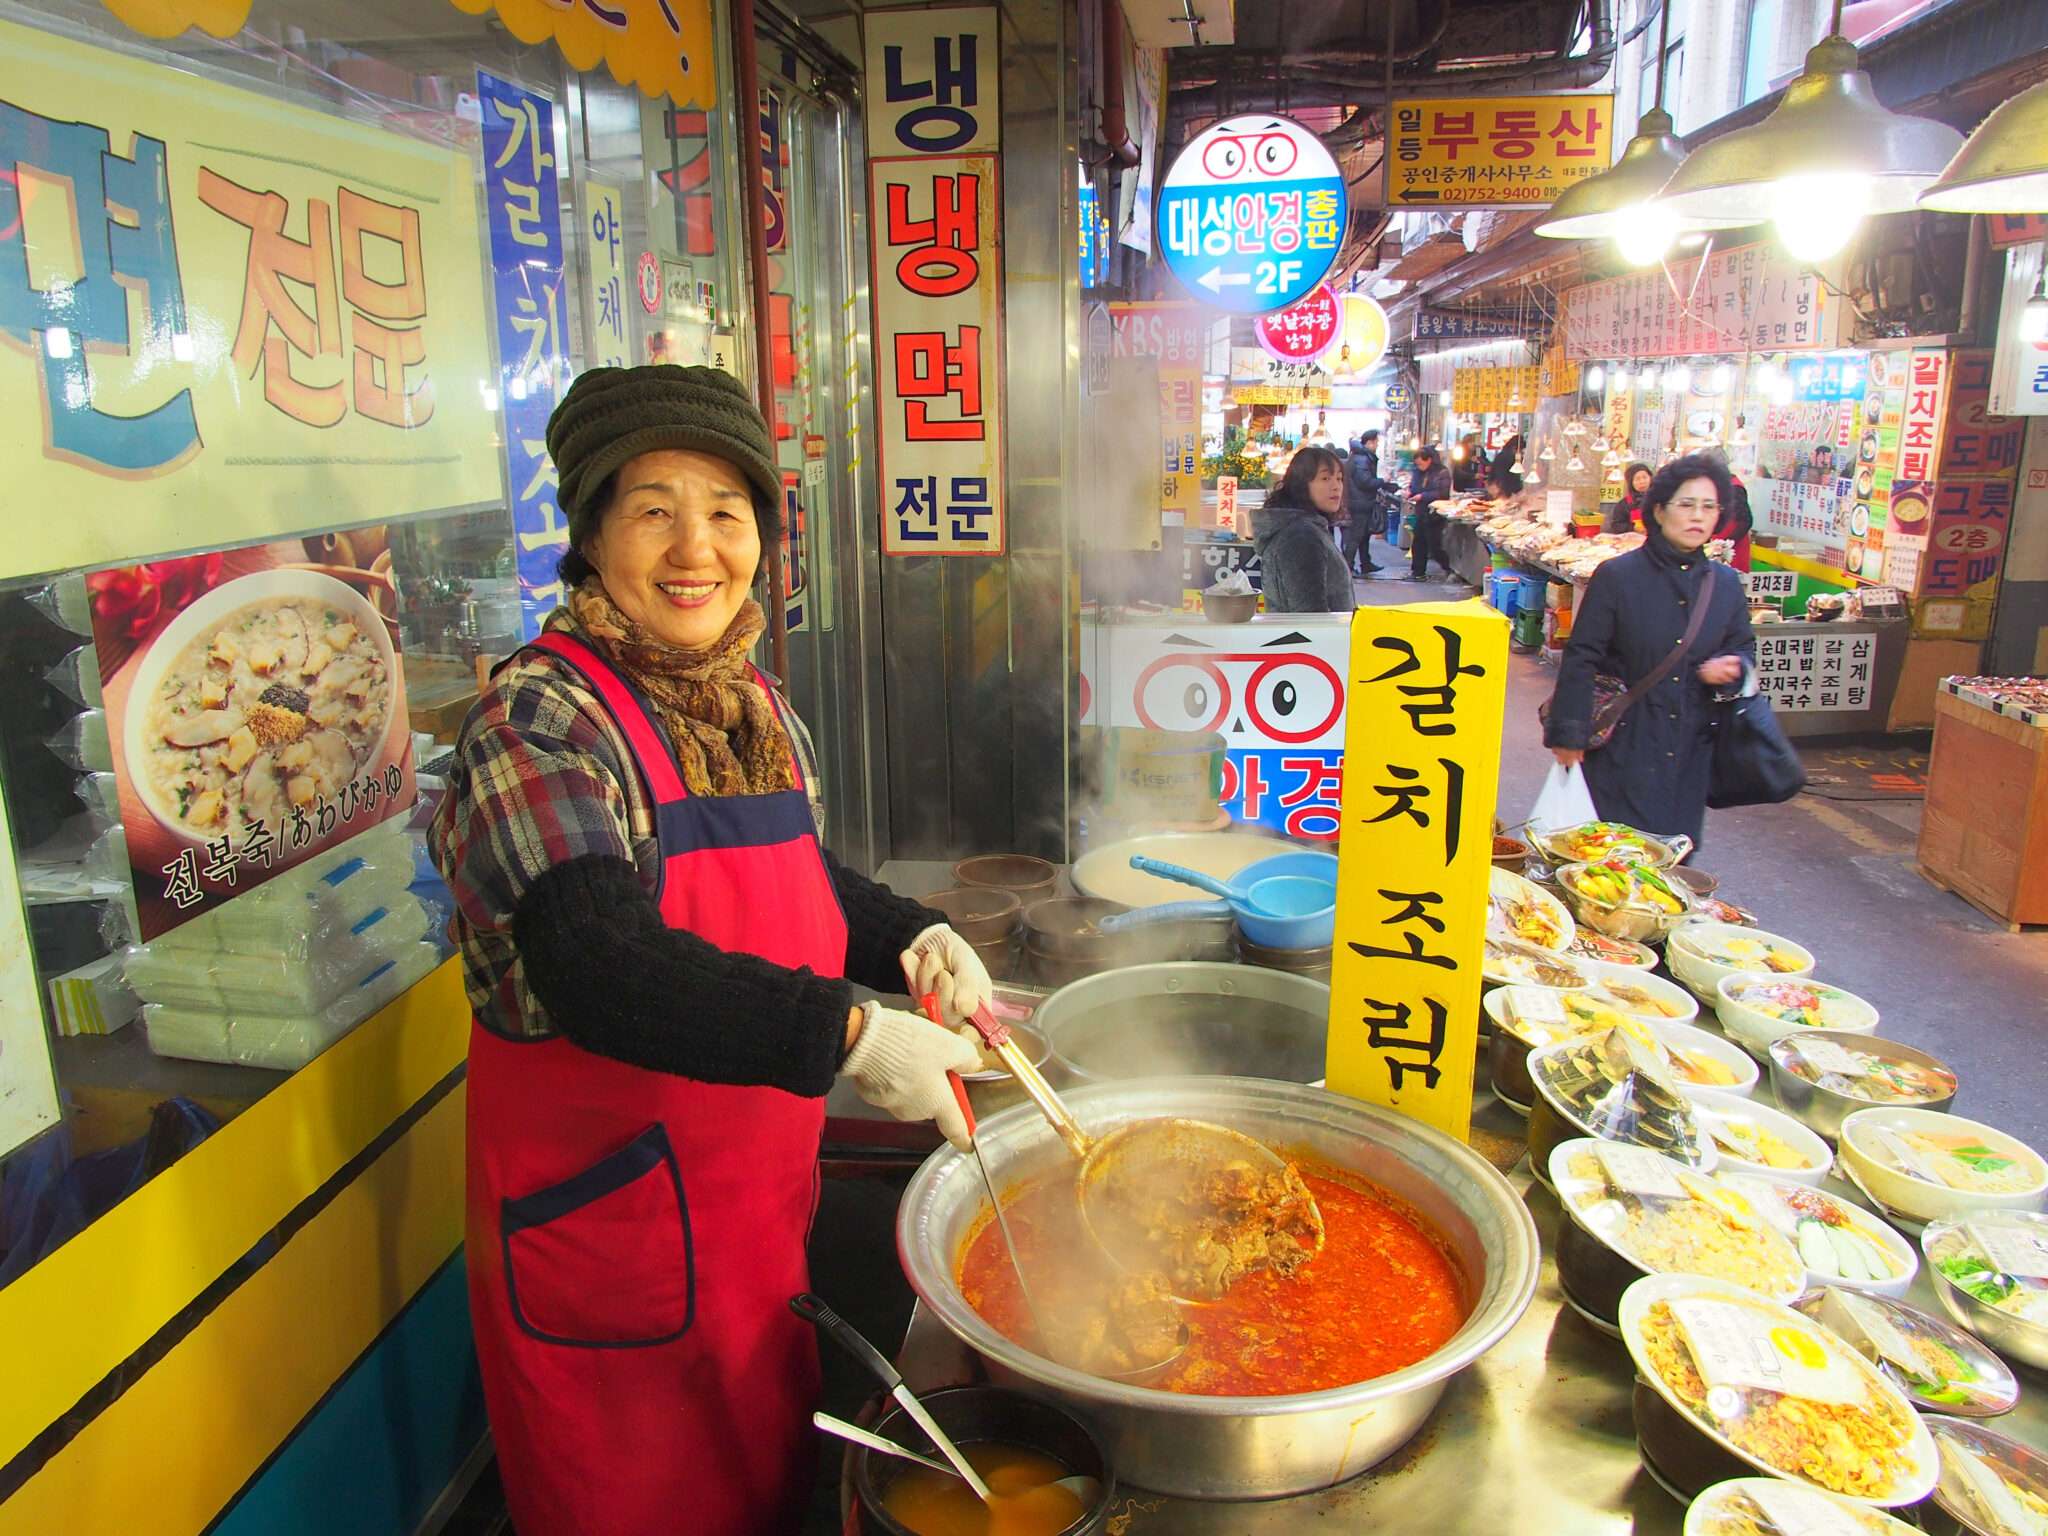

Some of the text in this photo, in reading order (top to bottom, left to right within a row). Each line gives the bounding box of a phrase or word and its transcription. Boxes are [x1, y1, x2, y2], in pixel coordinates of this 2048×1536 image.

[884, 33, 979, 153] 냉
[1397, 107, 1603, 162] 일등 부동산
[1402, 164, 1553, 185] 공인중개사사무소
[1443, 187, 1541, 201] 02)752-9400
[1167, 190, 1303, 256] 대성안경
[1305, 189, 1340, 250] 총판
[198, 164, 435, 429] 전문
[593, 196, 627, 368] 야채
[1255, 259, 1304, 295] 2F
[886, 172, 986, 443] 냉면
[1113, 315, 1164, 360] KBS
[494, 96, 572, 636] 갈치조
[1902, 356, 1943, 481] 갈치조림
[1946, 431, 2018, 469] 도매
[893, 474, 994, 542] 전문
[1937, 484, 2010, 520] 그릇
[1947, 528, 1989, 549] 2층
[1751, 575, 1793, 592] 갈치조림
[1760, 657, 1813, 672] 보리 밥
[1761, 638, 1815, 655] 순대국밥
[1820, 639, 1844, 706] 갈치조림
[1847, 639, 1870, 705] 삼계탕
[1759, 675, 1813, 691] 잔치국수
[1347, 625, 1487, 1092] 갈치조림
